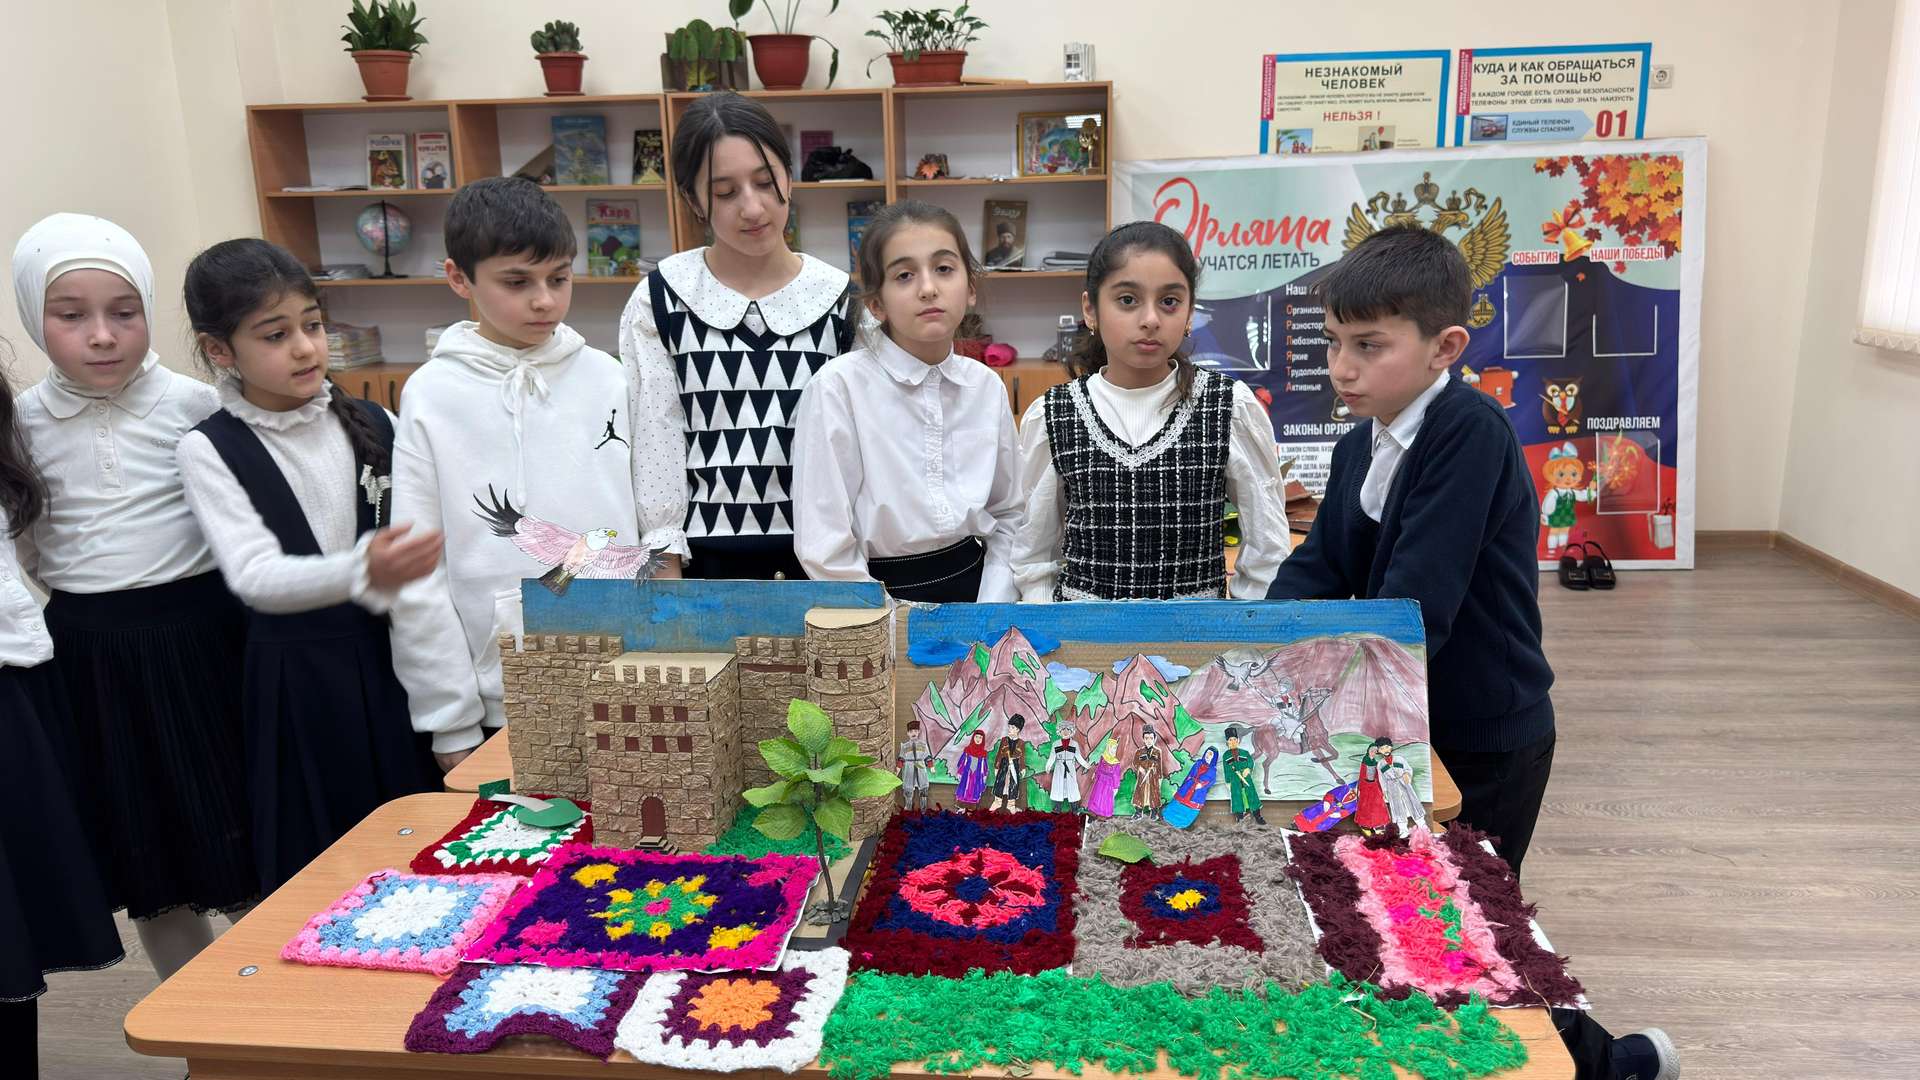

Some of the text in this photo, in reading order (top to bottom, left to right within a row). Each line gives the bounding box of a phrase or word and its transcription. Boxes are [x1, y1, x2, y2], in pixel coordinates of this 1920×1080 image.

[1305, 63, 1403, 78] НЕЗНАКОМЫЙ
[1473, 58, 1636, 74] КУДА И КАК ОБРАЩАТЬСЯ
[1321, 78, 1386, 90] ЧЕЛОВЕК
[1500, 72, 1602, 85] ЗА ПОМОЩЬЮ
[1323, 111, 1373, 122] НЕЛЬЗЯ
[1541, 118, 1571, 126] ТЕЛЕФОН
[1596, 110, 1628, 138] 01
[1512, 251, 1558, 264] СОБЫТИЯ
[1591, 247, 1664, 261] НАШИ ПОБЕДЫ
[1199, 252, 1320, 271] УЧАТСЯ ЛЕТАТЬ
[1286, 320, 1324, 331] Разностор
[1286, 351, 1309, 362] Яркие
[1286, 382, 1322, 393] Активные
[1587, 416, 1661, 430] ПОЗДРАВЛЯЕМ
[1283, 424, 1323, 436] ЗАКОНЫ
